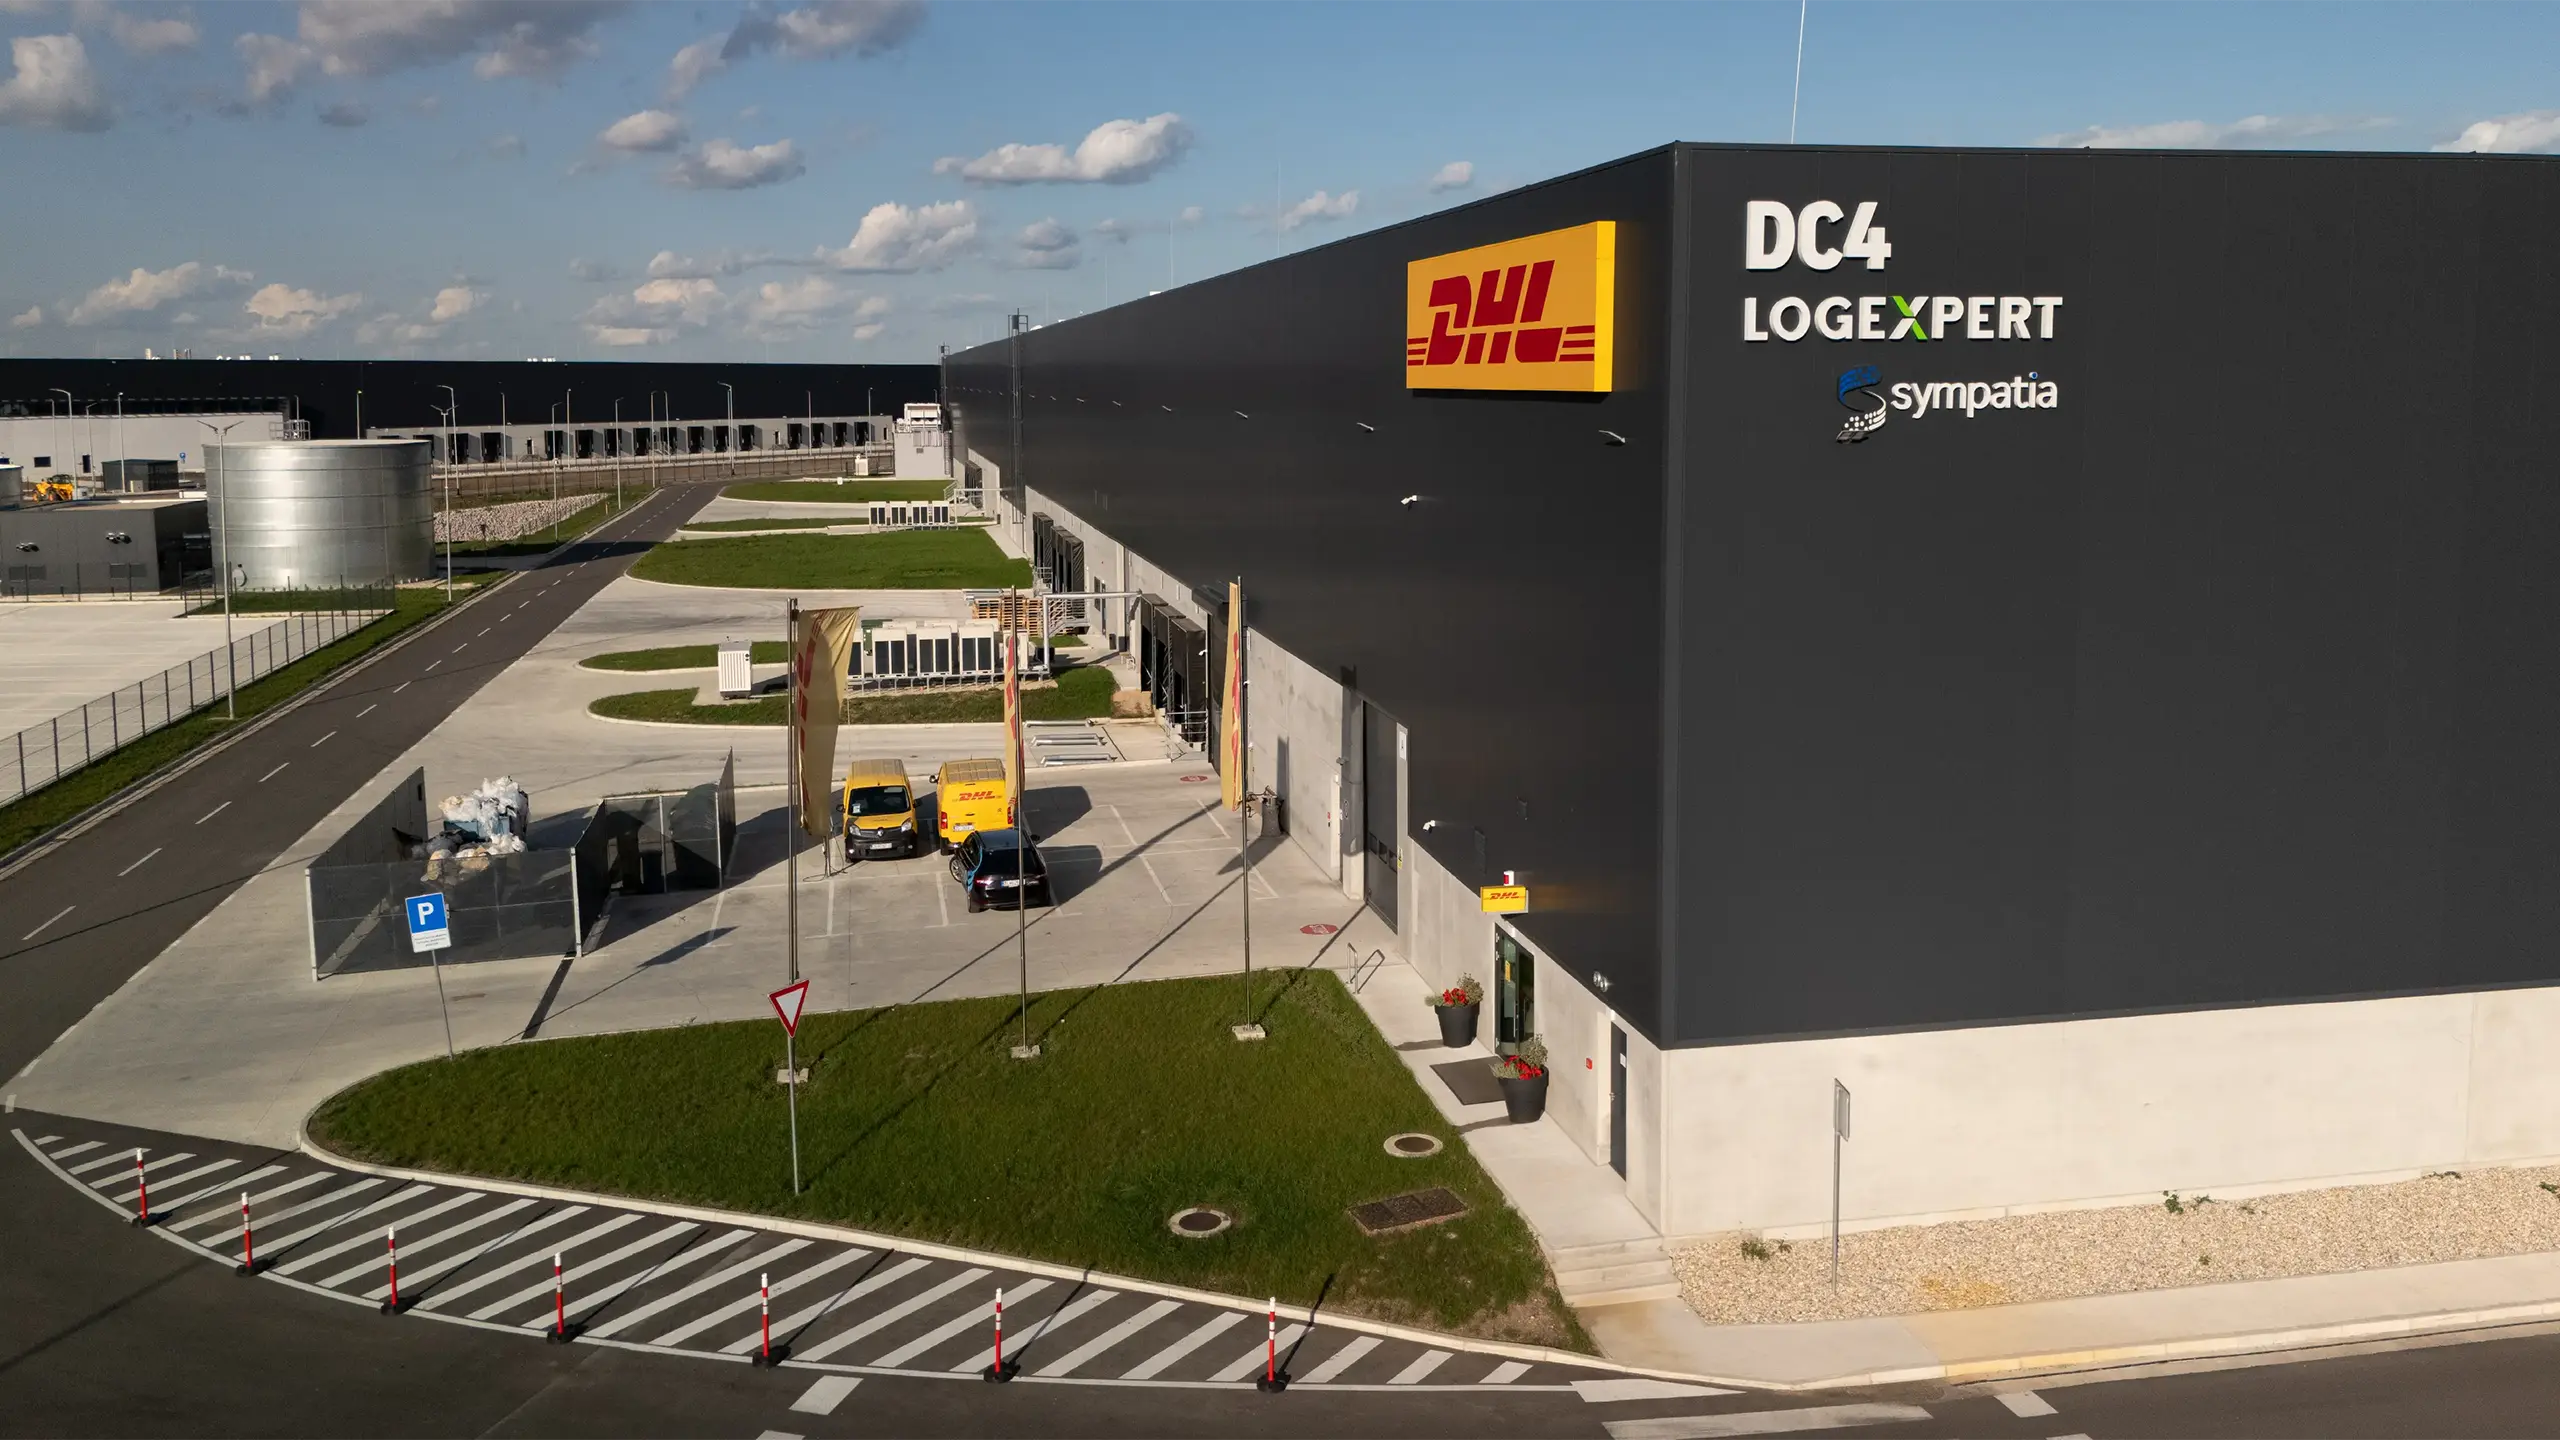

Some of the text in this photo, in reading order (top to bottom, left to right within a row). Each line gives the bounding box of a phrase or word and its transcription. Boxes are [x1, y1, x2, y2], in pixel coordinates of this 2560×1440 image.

[1746, 200, 1892, 270] DC4
[1424, 259, 1563, 366] DHL
[1744, 295, 2064, 342] LOGEXPERT
[1890, 371, 2058, 418] sympatia
[959, 790, 996, 801] DHL
[417, 902, 434, 925] P
[1490, 892, 1520, 900] DHL
